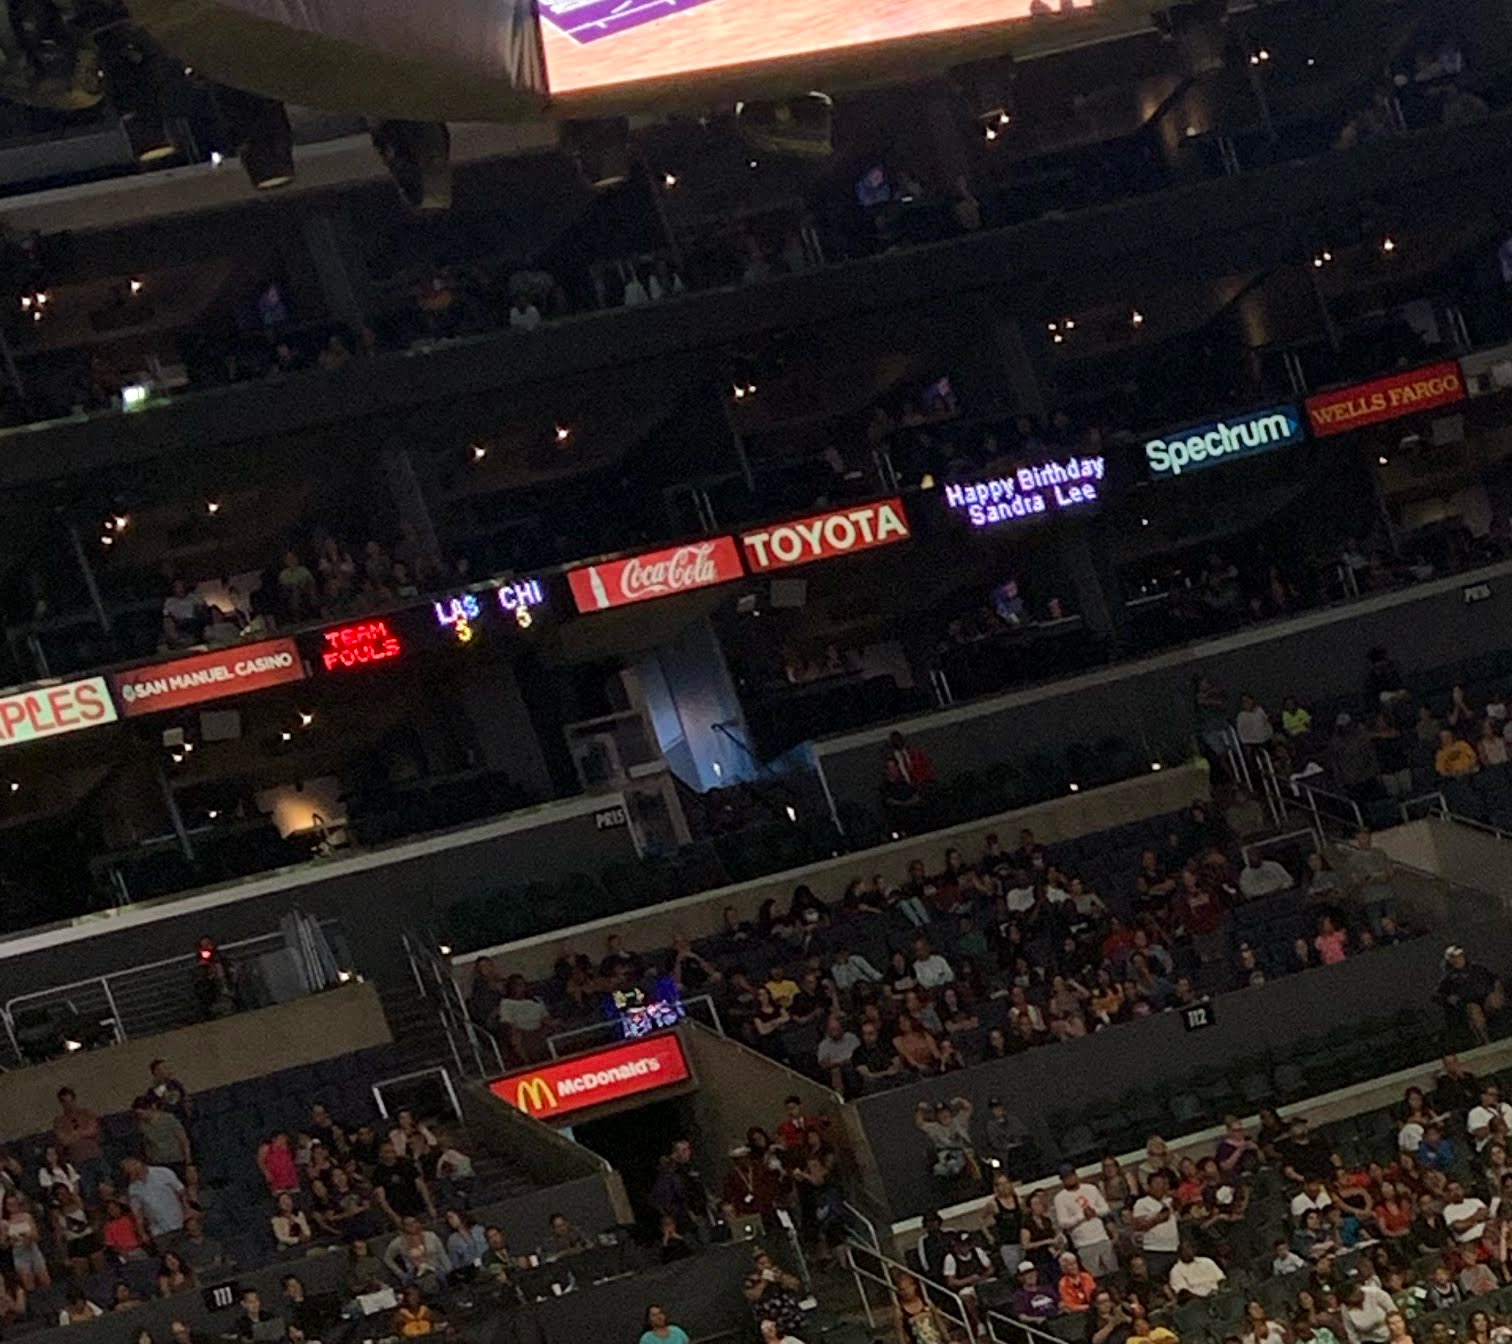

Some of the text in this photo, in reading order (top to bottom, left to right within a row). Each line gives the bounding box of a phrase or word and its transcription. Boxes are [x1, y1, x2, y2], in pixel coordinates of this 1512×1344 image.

[1312, 374, 1460, 427] WELLS FARGO
[1146, 412, 1290, 474] Spectrum
[945, 455, 1106, 518] Happy Birthday
[968, 481, 1096, 527] Sandra Lee
[745, 503, 908, 567] TOYOTA
[435, 595, 481, 626] LAS
[498, 578, 544, 612] CHI
[323, 641, 401, 672] FOULS
[324, 622, 388, 648] TEAM
[134, 651, 293, 698] SAN MANUEL CASINO
[0, 684, 106, 740] PLES
[1187, 1008, 1208, 1027] 112
[557, 1055, 661, 1097] McDonald's
